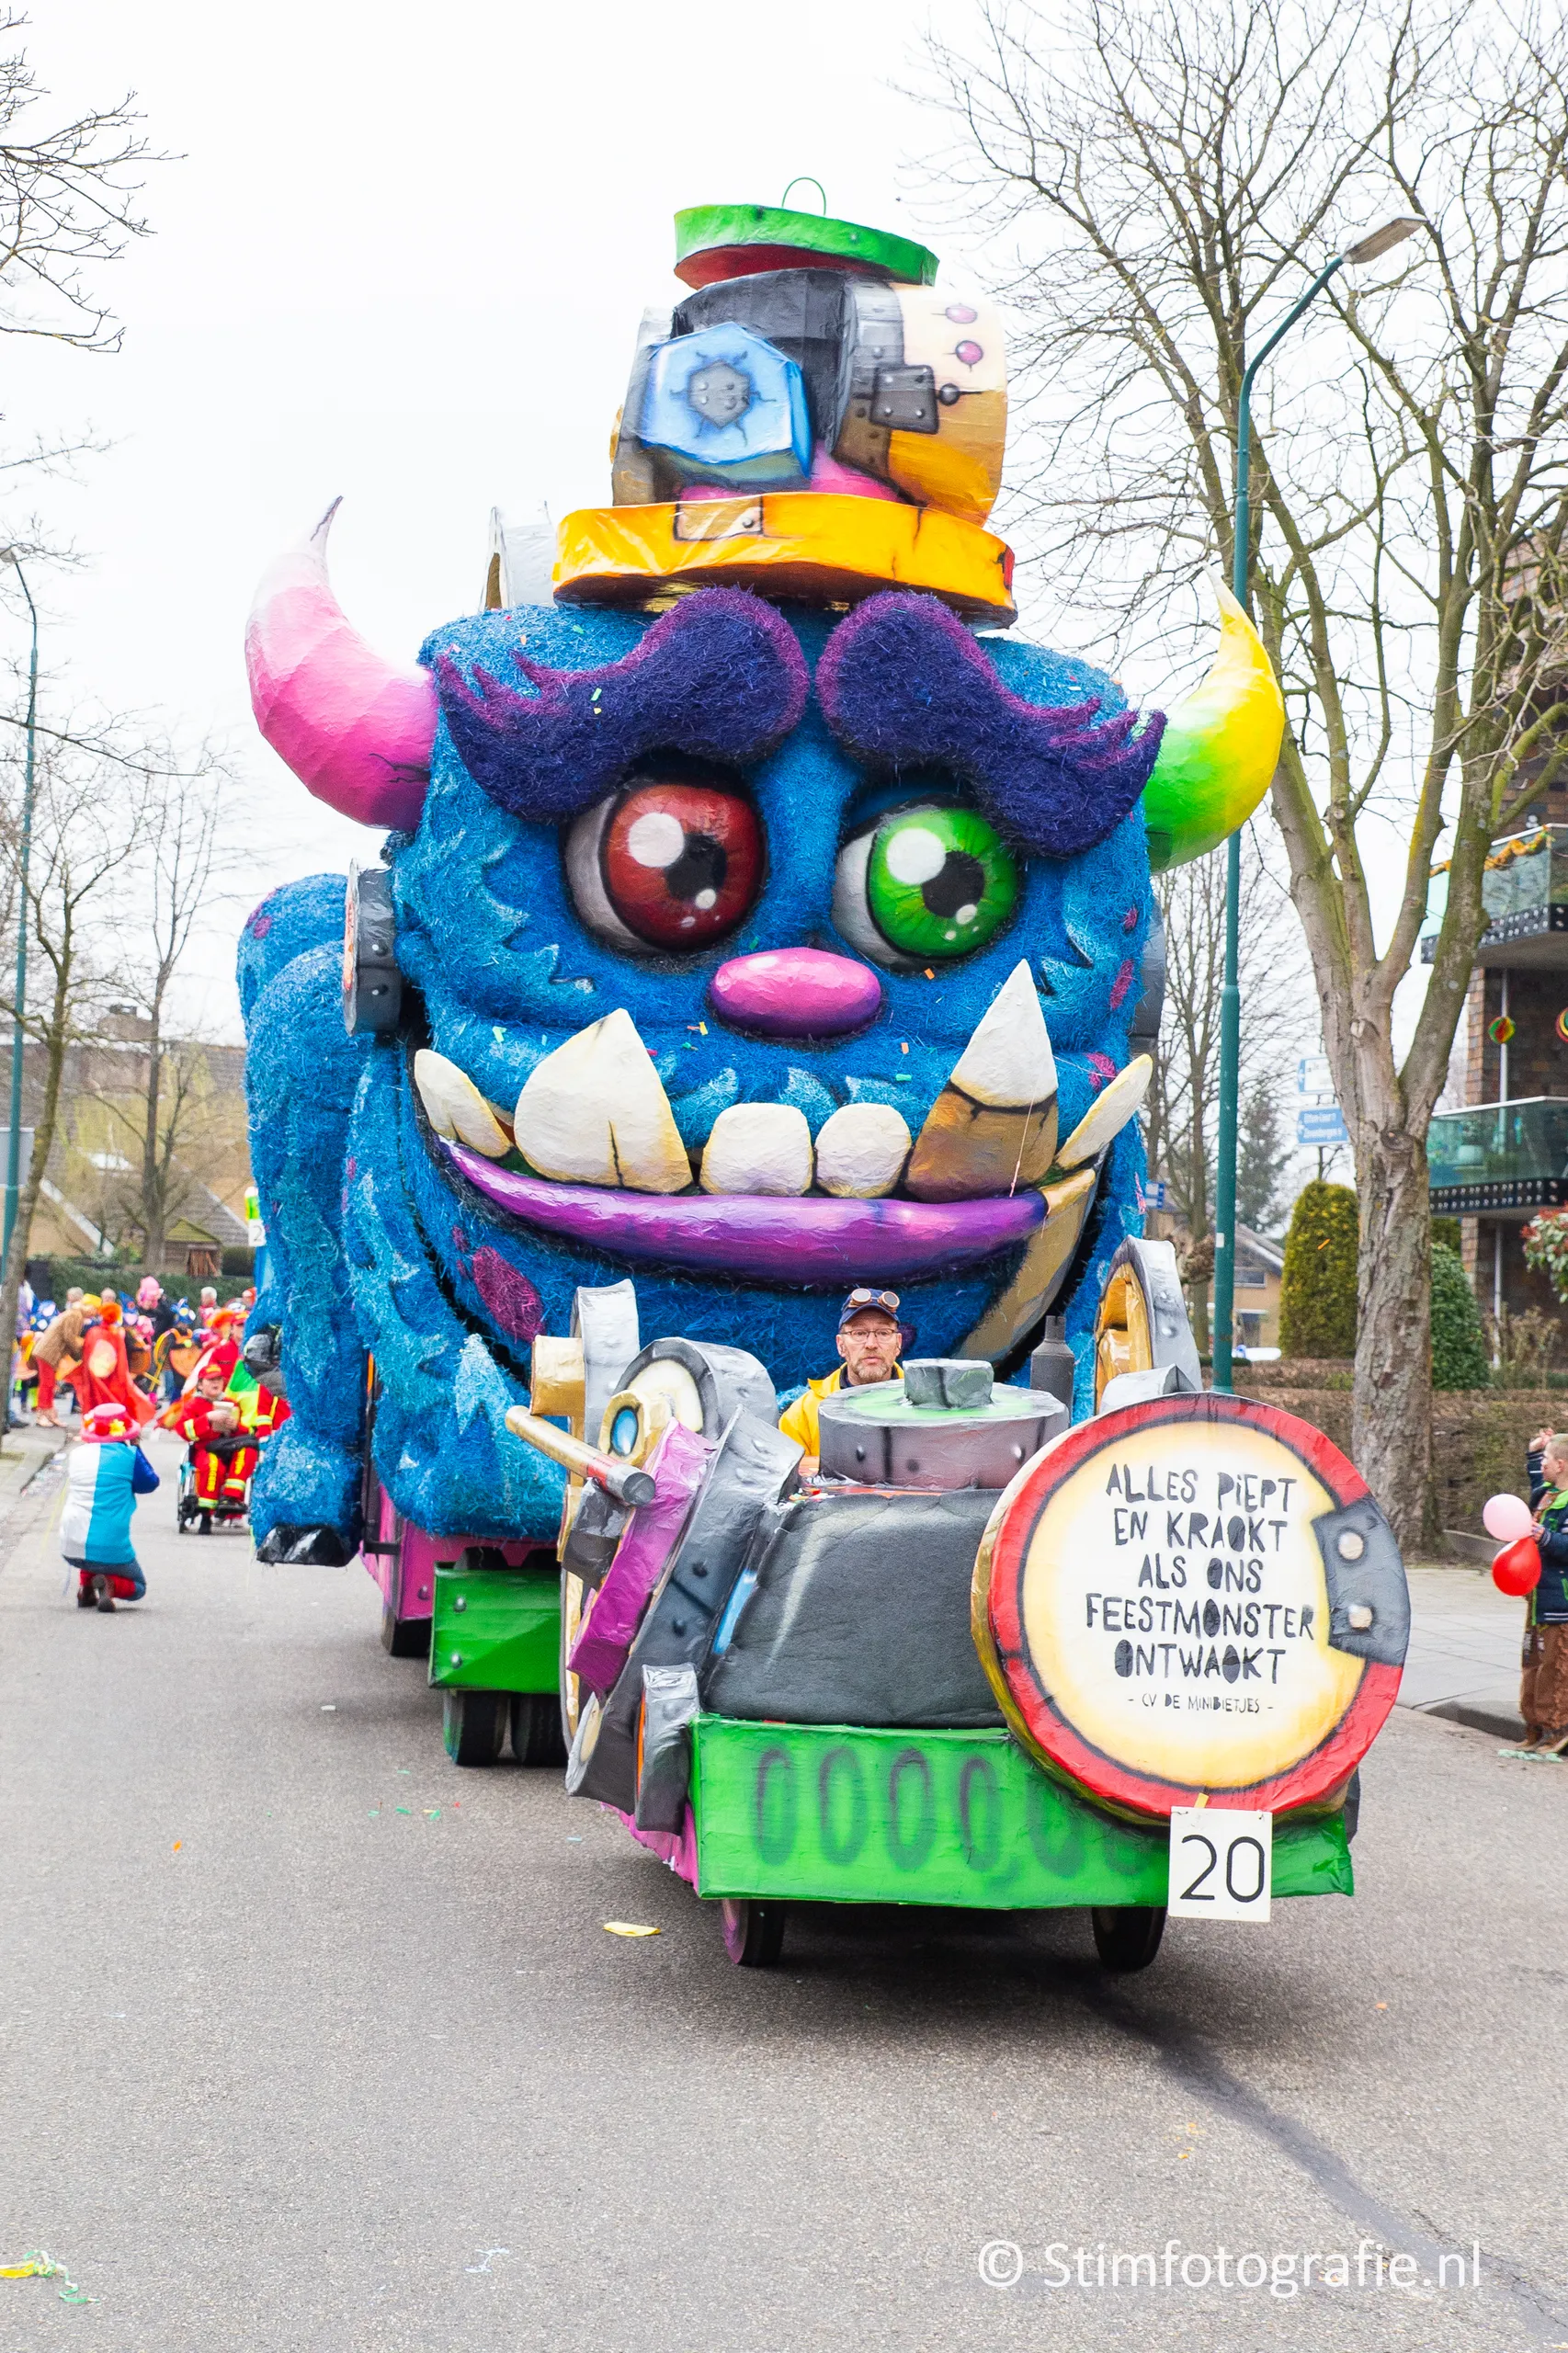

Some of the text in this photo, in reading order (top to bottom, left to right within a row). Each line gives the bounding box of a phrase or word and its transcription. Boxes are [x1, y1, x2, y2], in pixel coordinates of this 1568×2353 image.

[1106, 1463, 1198, 1504] ALLES
[1114, 1508, 1148, 1546] EN
[1138, 1552, 1264, 1594] ALS ONS
[1085, 1593, 1314, 1641] FEESTMONSTER
[1142, 1693, 1157, 1707] CV
[1165, 1693, 1181, 1709] DE
[1180, 1834, 1265, 1903] 20
